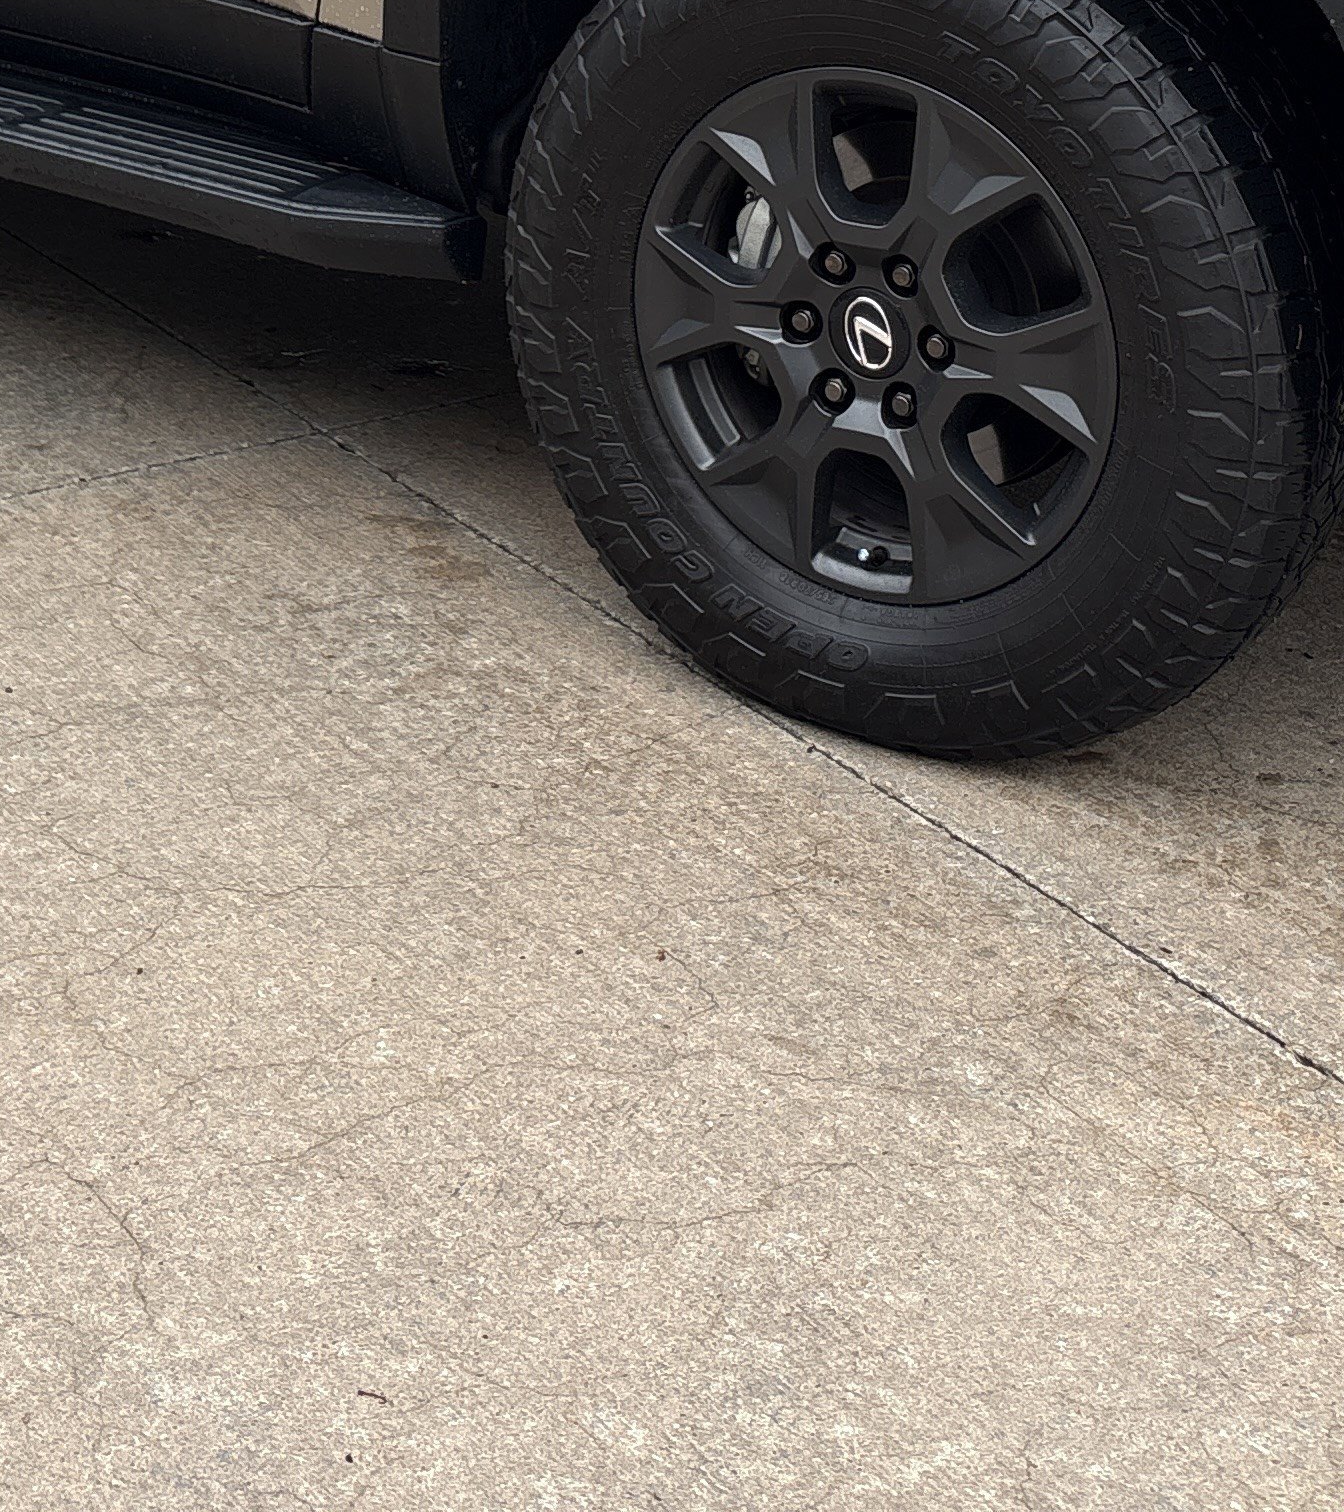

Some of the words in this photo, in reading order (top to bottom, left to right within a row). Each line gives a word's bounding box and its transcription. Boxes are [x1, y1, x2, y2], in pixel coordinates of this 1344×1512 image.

[934, 30, 1095, 170] TOYO
[1094, 175, 1178, 417] TIRES
[564, 315, 717, 588] COUNTRY
[709, 580, 870, 674] OPEN
